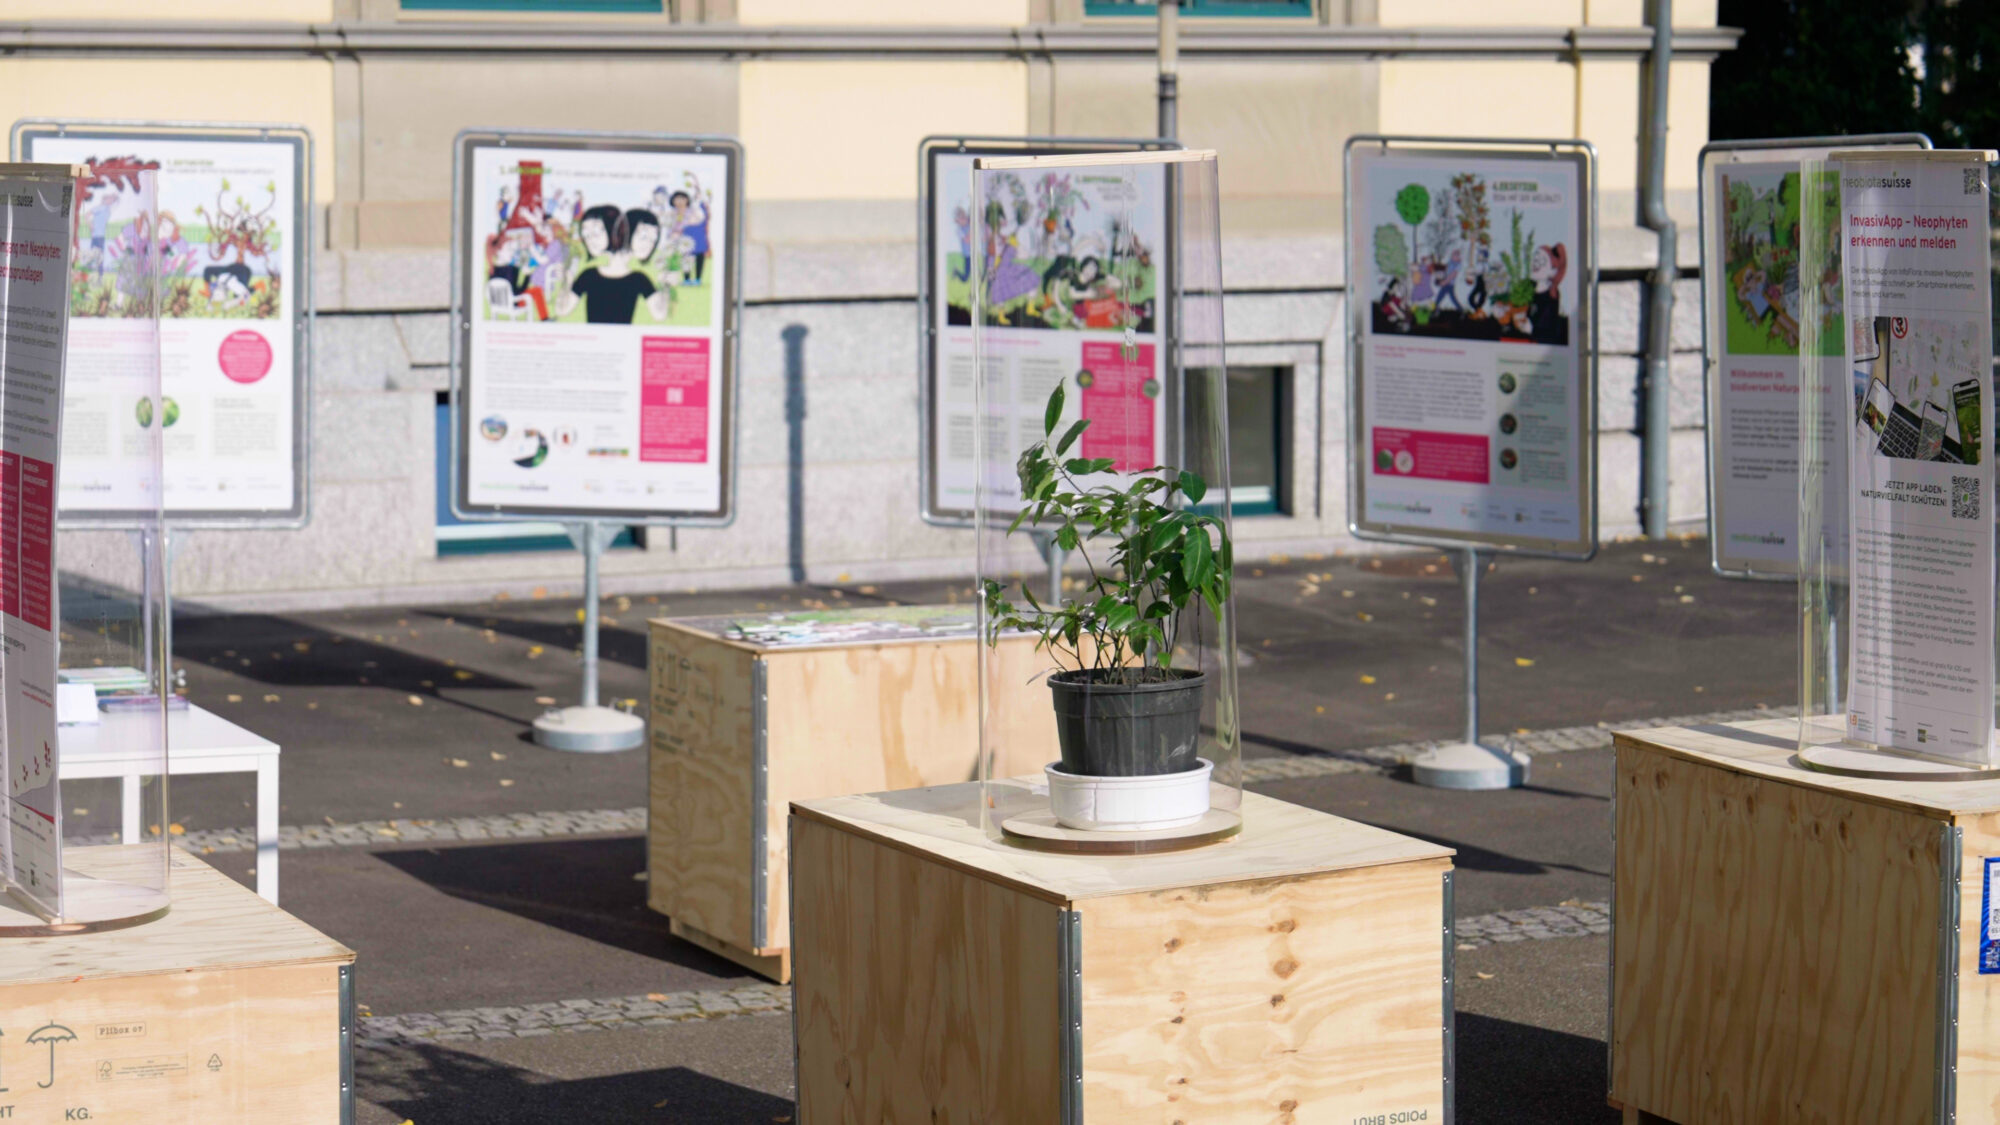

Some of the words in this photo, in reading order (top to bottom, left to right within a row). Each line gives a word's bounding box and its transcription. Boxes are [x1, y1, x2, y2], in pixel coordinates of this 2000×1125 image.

[1850, 214, 1902, 229] InvasivApp
[1913, 215, 1968, 231] Neophyten
[1850, 235, 1896, 247] erkennen
[1899, 236, 1916, 248] und
[1920, 236, 1956, 249] melden
[1885, 480, 1904, 489] JETZT
[1906, 482, 1918, 491] APP
[1920, 484, 1942, 494] LADEN
[1861, 490, 1909, 503] NATURVIELFALT
[65, 1107, 93, 1121] KG.
[1389, 1109, 1427, 1124] POIDS
